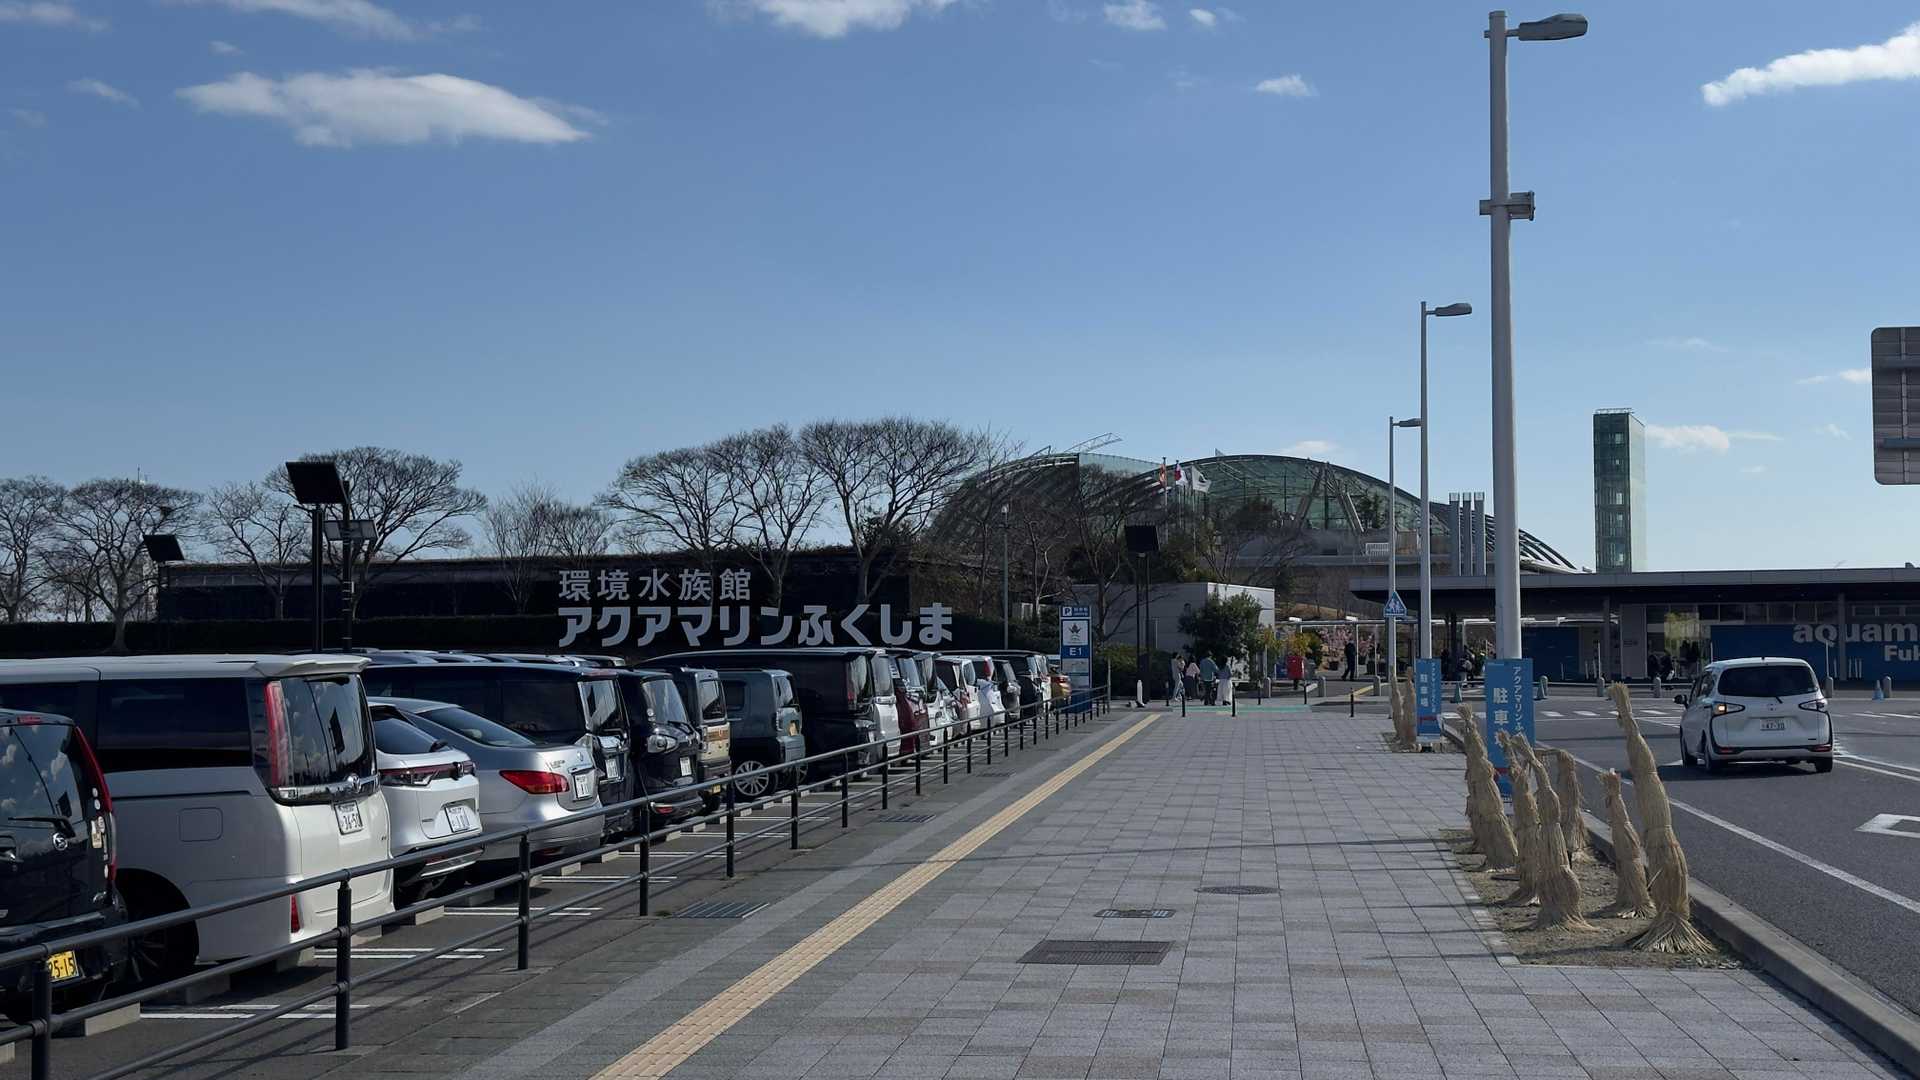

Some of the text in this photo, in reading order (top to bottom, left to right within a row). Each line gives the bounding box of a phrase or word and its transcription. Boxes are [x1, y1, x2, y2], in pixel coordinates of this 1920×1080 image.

[558, 568, 752, 602] 環境水族館
[557, 602, 953, 647] アクアマリンふくしま
[1793, 623, 1920, 646] aquam
[1069, 647, 1082, 656] E1
